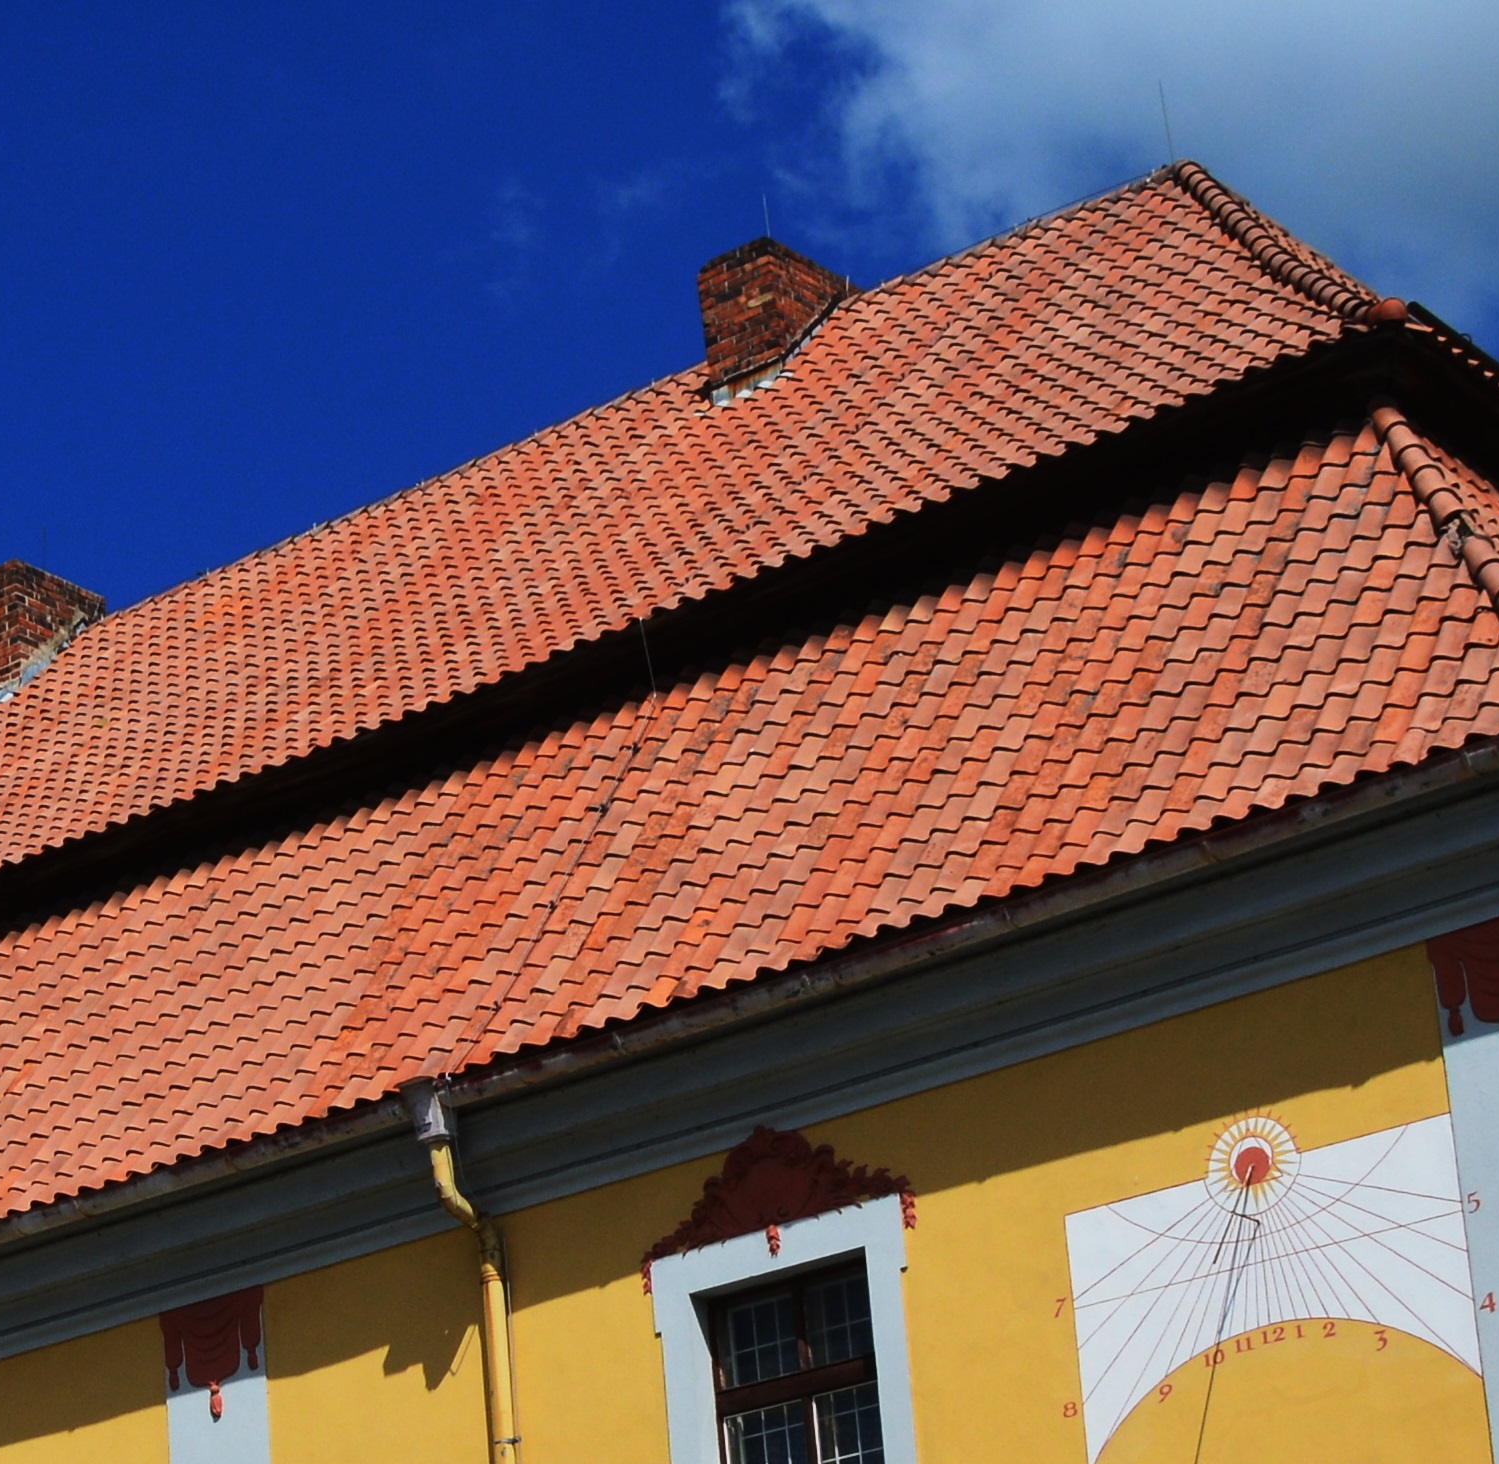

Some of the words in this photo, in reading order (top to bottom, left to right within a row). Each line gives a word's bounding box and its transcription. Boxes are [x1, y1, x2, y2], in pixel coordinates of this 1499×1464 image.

[1467, 1191, 1481, 1214] 5
[1053, 1297, 1067, 1319] 7
[1479, 1291, 1496, 1313] 4
[1261, 1326, 1285, 1344] 12
[1295, 1324, 1306, 1339] 1
[1322, 1321, 1336, 1339] 2
[1235, 1337, 1255, 1353] 11
[1373, 1329, 1388, 1352] 3
[1203, 1349, 1226, 1367] 10
[1158, 1383, 1173, 1404] 9
[1063, 1401, 1078, 1418] 8
